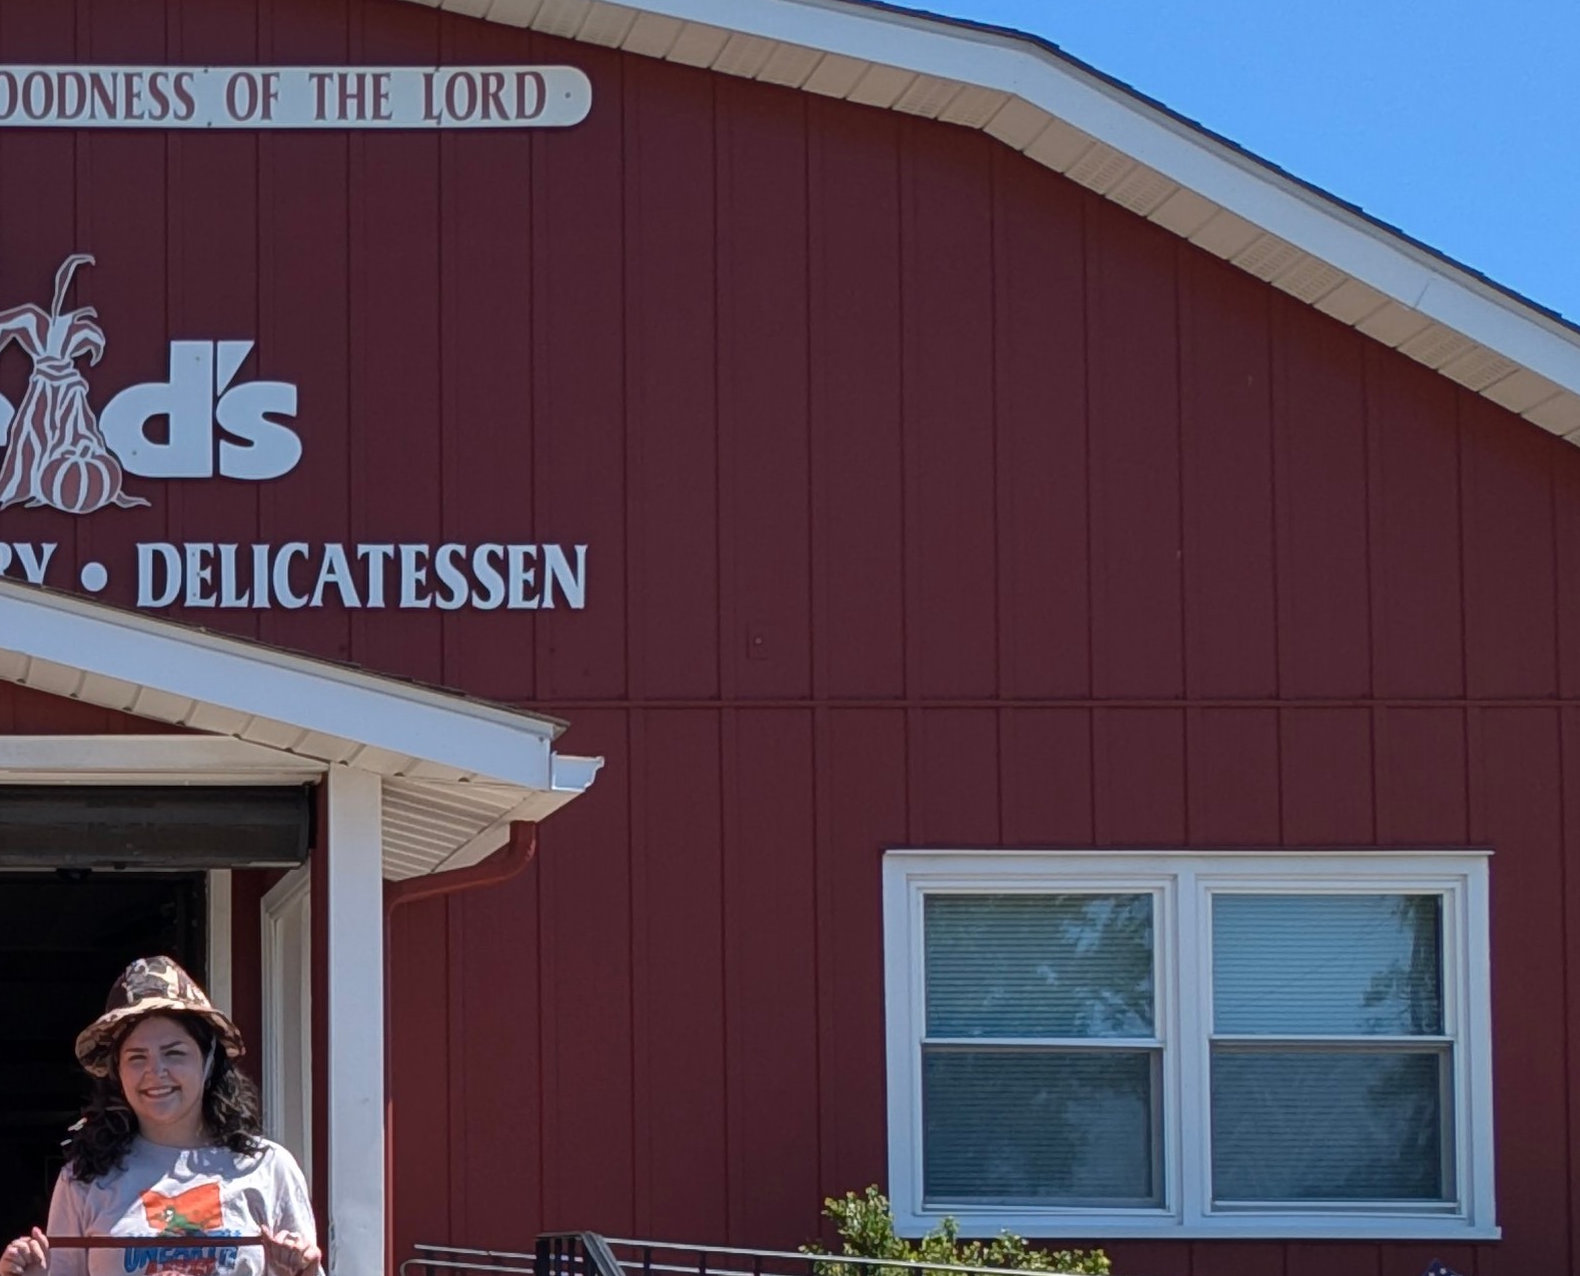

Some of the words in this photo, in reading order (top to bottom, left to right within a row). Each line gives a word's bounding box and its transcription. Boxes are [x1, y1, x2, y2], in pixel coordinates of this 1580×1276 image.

[225, 71, 280, 120] OF
[308, 71, 393, 120] THE
[422, 70, 547, 121] LORD
[136, 542, 588, 610] DELICATESSEN
